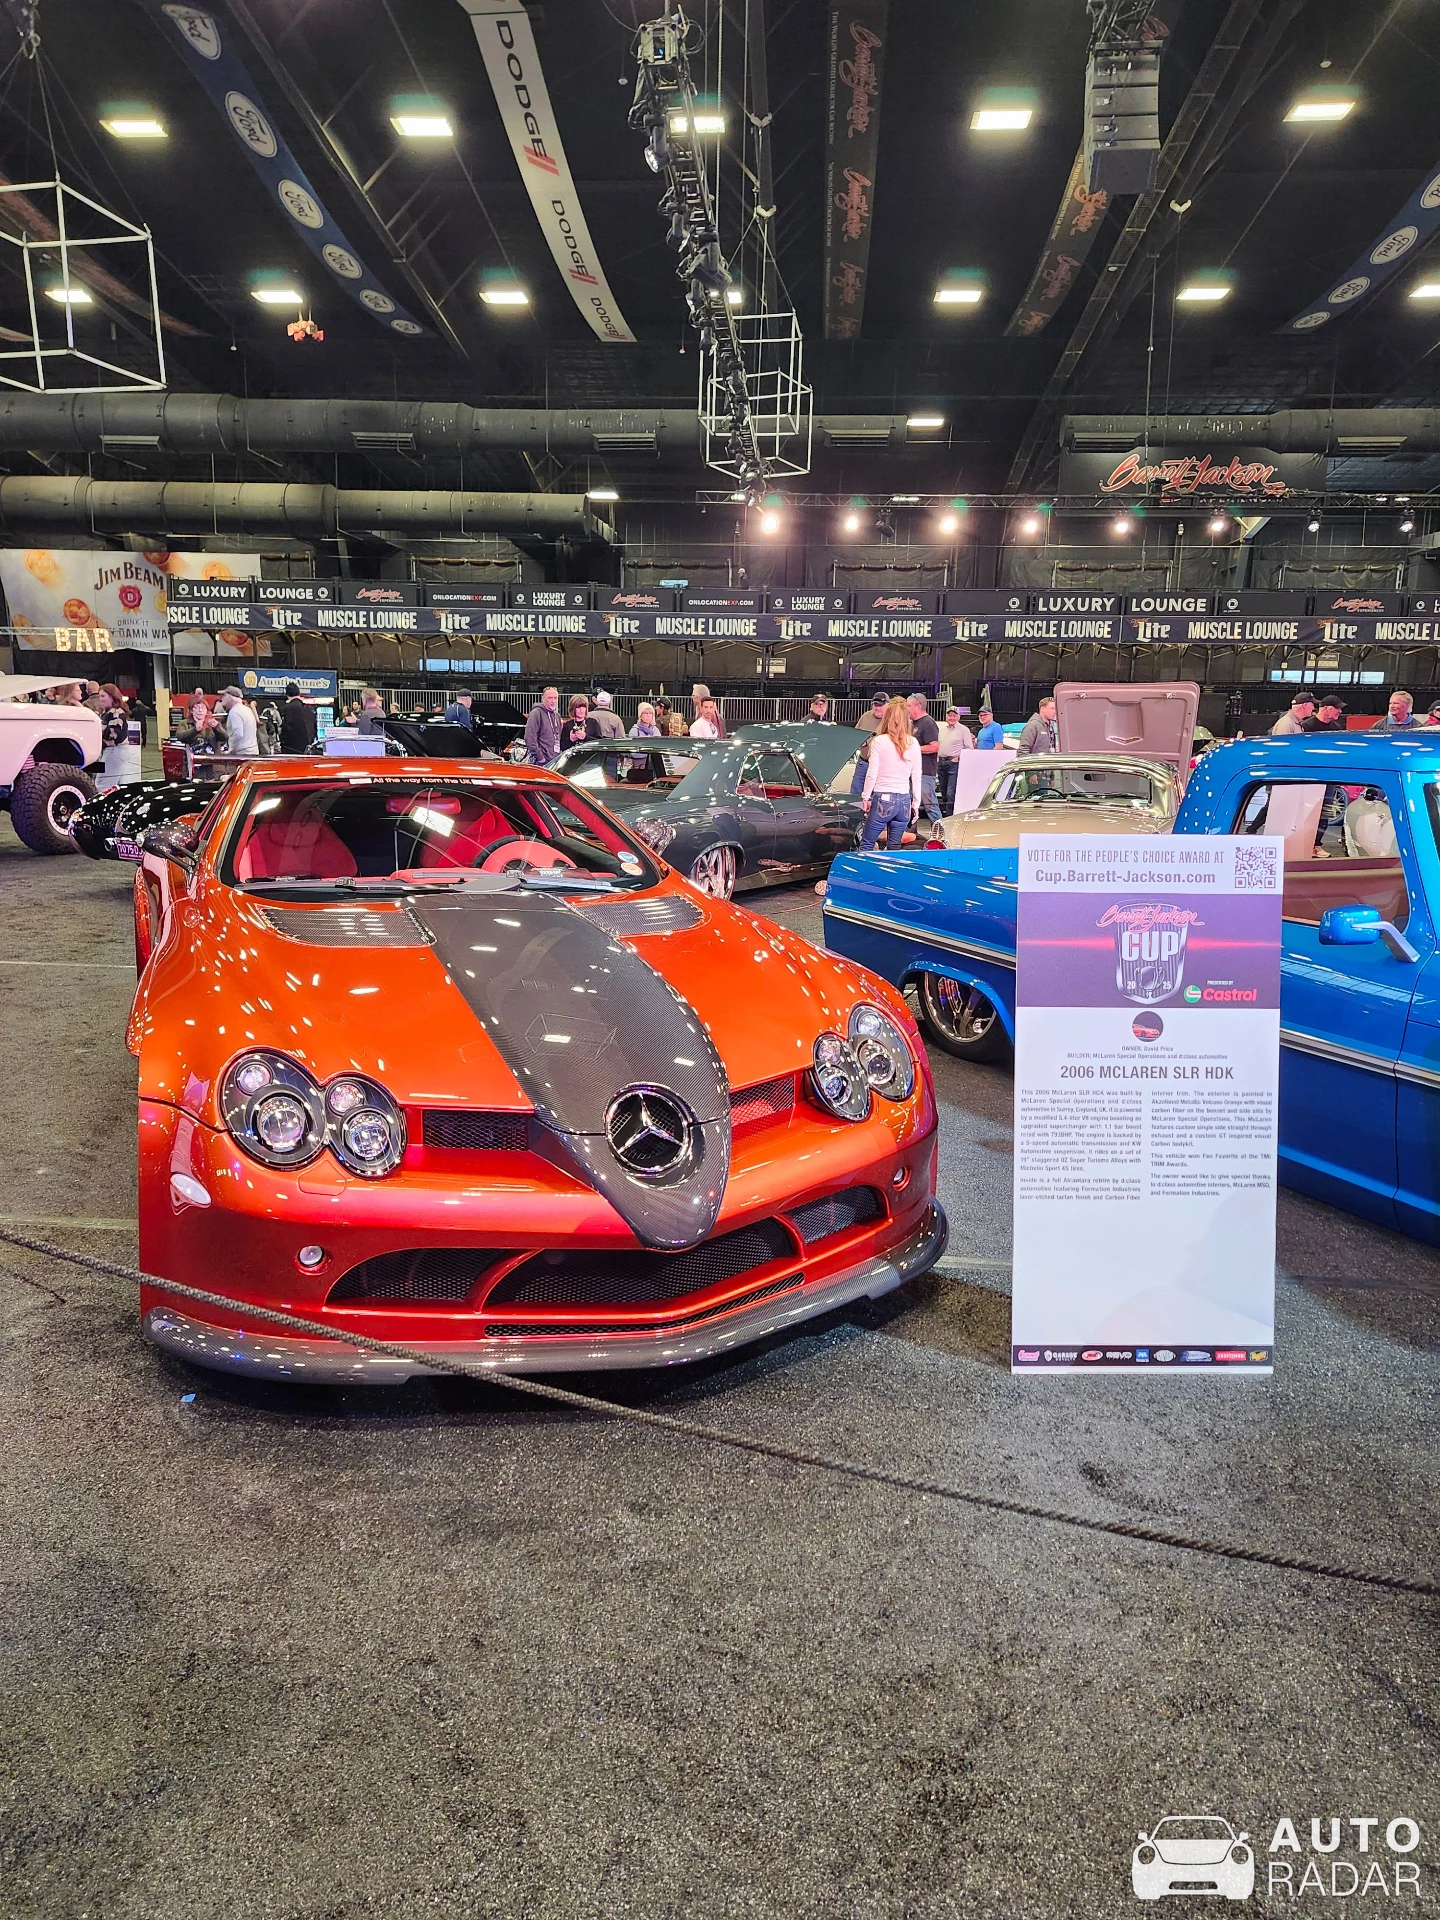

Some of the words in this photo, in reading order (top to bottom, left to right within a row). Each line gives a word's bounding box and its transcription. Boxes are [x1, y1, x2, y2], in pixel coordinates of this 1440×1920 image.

[496, 20, 547, 157] DODGE
[232, 105, 267, 148] Ford
[285, 188, 314, 219] Ford
[551, 199, 589, 276] DODGE
[1377, 234, 1410, 257] Ford
[328, 251, 355, 272] Ford
[590, 297, 618, 336] DODGE
[94, 566, 121, 590] JIM
[123, 562, 164, 590] BEAM
[193, 585, 247, 598] LUXURY
[259, 587, 314, 599] LOUNGE
[533, 592, 566, 600] LUXURY
[791, 596, 826, 604] LUXURY
[1038, 597, 1115, 612] LUXURY
[1131, 598, 1207, 612] LOUNGE
[117, 618, 140, 627] DRINK
[202, 606, 250, 625] LOUNGE
[272, 608, 302, 630] Lite
[318, 610, 367, 628] MUSCLE
[370, 611, 417, 629] LOUNGE
[439, 613, 471, 633] Lite
[486, 613, 535, 632] MUSCLE
[538, 614, 586, 633] LOUNGE
[608, 616, 640, 637] Lite
[656, 617, 705, 635] MUSCLE
[708, 618, 757, 636] LOUNGE
[779, 619, 812, 640] Lite
[828, 619, 879, 637] MUSCLE
[881, 620, 932, 637] LOUNGE
[954, 620, 988, 642] Lite
[1004, 620, 1058, 638] MUSCLE
[1060, 621, 1113, 638] LOUNGE
[1136, 622, 1171, 642] Lite
[1188, 621, 1242, 639] MUSCLE
[1245, 622, 1299, 639] LOUNGE
[1322, 623, 1358, 644] Lite
[1375, 622, 1431, 640] MUSCLE
[54, 627, 115, 653] BAR
[1027, 849, 1051, 862] VOTE
[1054, 850, 1071, 862] FOR
[1075, 850, 1092, 862] THE
[1096, 850, 1139, 863] PEOPLE'S
[1142, 851, 1176, 863] CHOICE
[1179, 851, 1210, 863] AWARD
[1214, 851, 1225, 864] AT
[1035, 869, 1216, 884] Cup.Barrett-Jackson.com
[1096, 904, 1205, 933] Barrett-Jackson
[1121, 931, 1179, 962] CUP
[1127, 981, 1136, 990] 20
[1162, 981, 1171, 990] 25
[1202, 987, 1258, 1001] Castrol
[1060, 1065, 1094, 1079] 2006
[1099, 1066, 1167, 1079] MCLAREN
[1173, 1066, 1199, 1079] SLR
[1205, 1066, 1233, 1080] HDK
[1044, 1165, 1060, 1173] Sport
